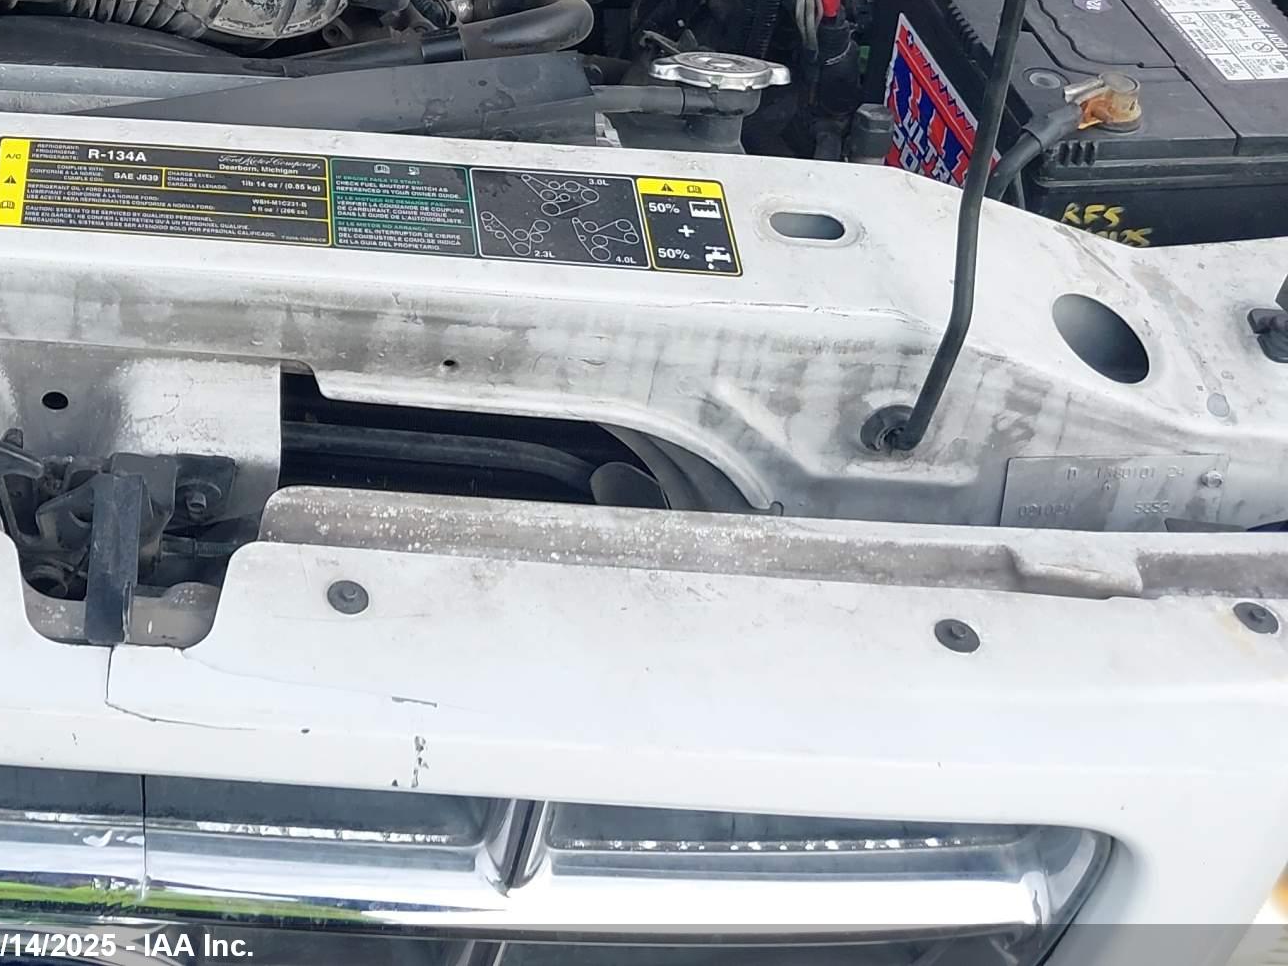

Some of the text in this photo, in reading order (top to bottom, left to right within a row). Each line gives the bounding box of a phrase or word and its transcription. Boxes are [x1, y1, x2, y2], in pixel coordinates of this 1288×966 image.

[87, 148, 146, 162] R-134A
[218, 154, 269, 166] Ford Motor
[219, 163, 297, 175] Dearborn, Michigan
[113, 172, 158, 182] SAE J639
[588, 178, 610, 186] 3.0L
[336, 185, 381, 193] REFERENCED
[648, 201, 680, 214] 50%
[353, 233, 402, 241] COMBUSTIBLE
[373, 228, 422, 237] INTERRUPTOR
[534, 249, 556, 258] 2.3L
[657, 247, 690, 260] 50%
[615, 255, 637, 264] 4.0L
